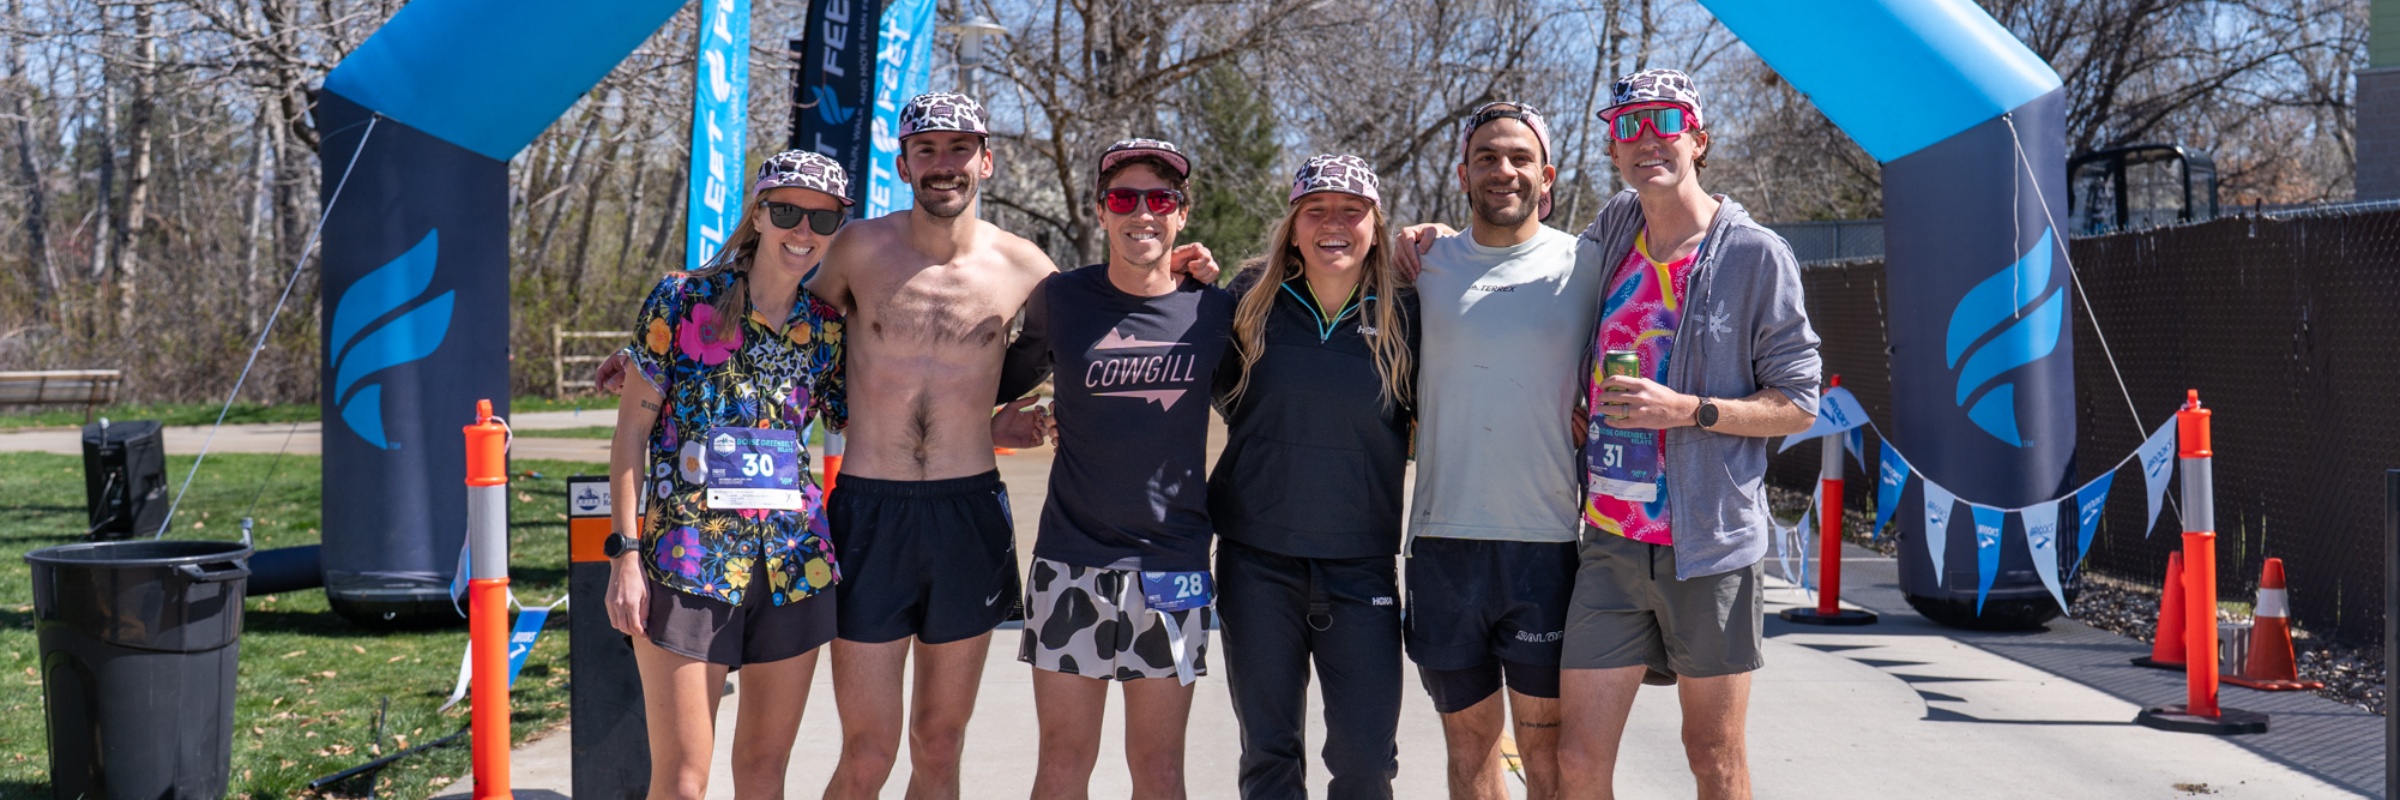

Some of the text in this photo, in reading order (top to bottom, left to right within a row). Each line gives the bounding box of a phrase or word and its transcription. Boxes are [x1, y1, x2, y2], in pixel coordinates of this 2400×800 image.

[859, 13, 868, 40] PAIN
[859, 43, 868, 77] MOVE
[859, 79, 869, 105] AND
[699, 105, 726, 268] FLEET
[1480, 284, 1516, 293] TERREX
[1356, 324, 1380, 336] HOK
[1085, 354, 1195, 388] COWGILL
[1826, 396, 1851, 427] BROOKS
[760, 439, 794, 448] GREENBELT
[1615, 430, 1653, 440] GREENBELT
[742, 453, 774, 477] 30
[1602, 443, 1624, 468] 31
[1977, 523, 2000, 538] BROOKS
[2029, 523, 2054, 537] BROOKS
[1174, 572, 1203, 599] 28
[1372, 596, 1394, 606] HOKA
[511, 631, 537, 643] BROOKS
